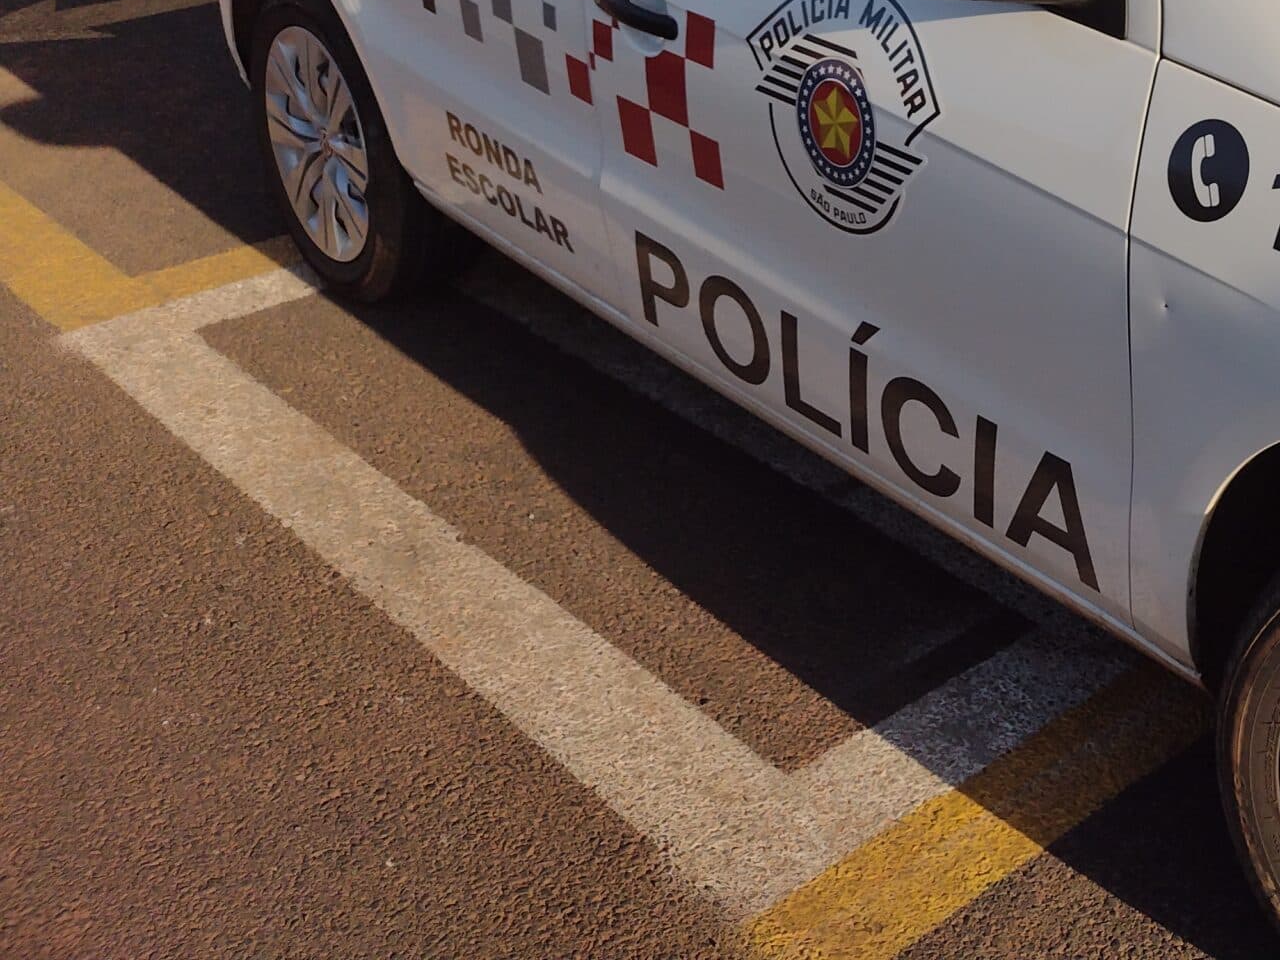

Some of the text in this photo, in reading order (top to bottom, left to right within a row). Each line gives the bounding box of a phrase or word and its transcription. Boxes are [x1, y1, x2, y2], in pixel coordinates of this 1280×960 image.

[446, 110, 544, 196] RONDA
[445, 152, 575, 254] ESCOLAR
[810, 188, 867, 224] SÃO PAULO
[634, 230, 1101, 593] POLÍCIA
